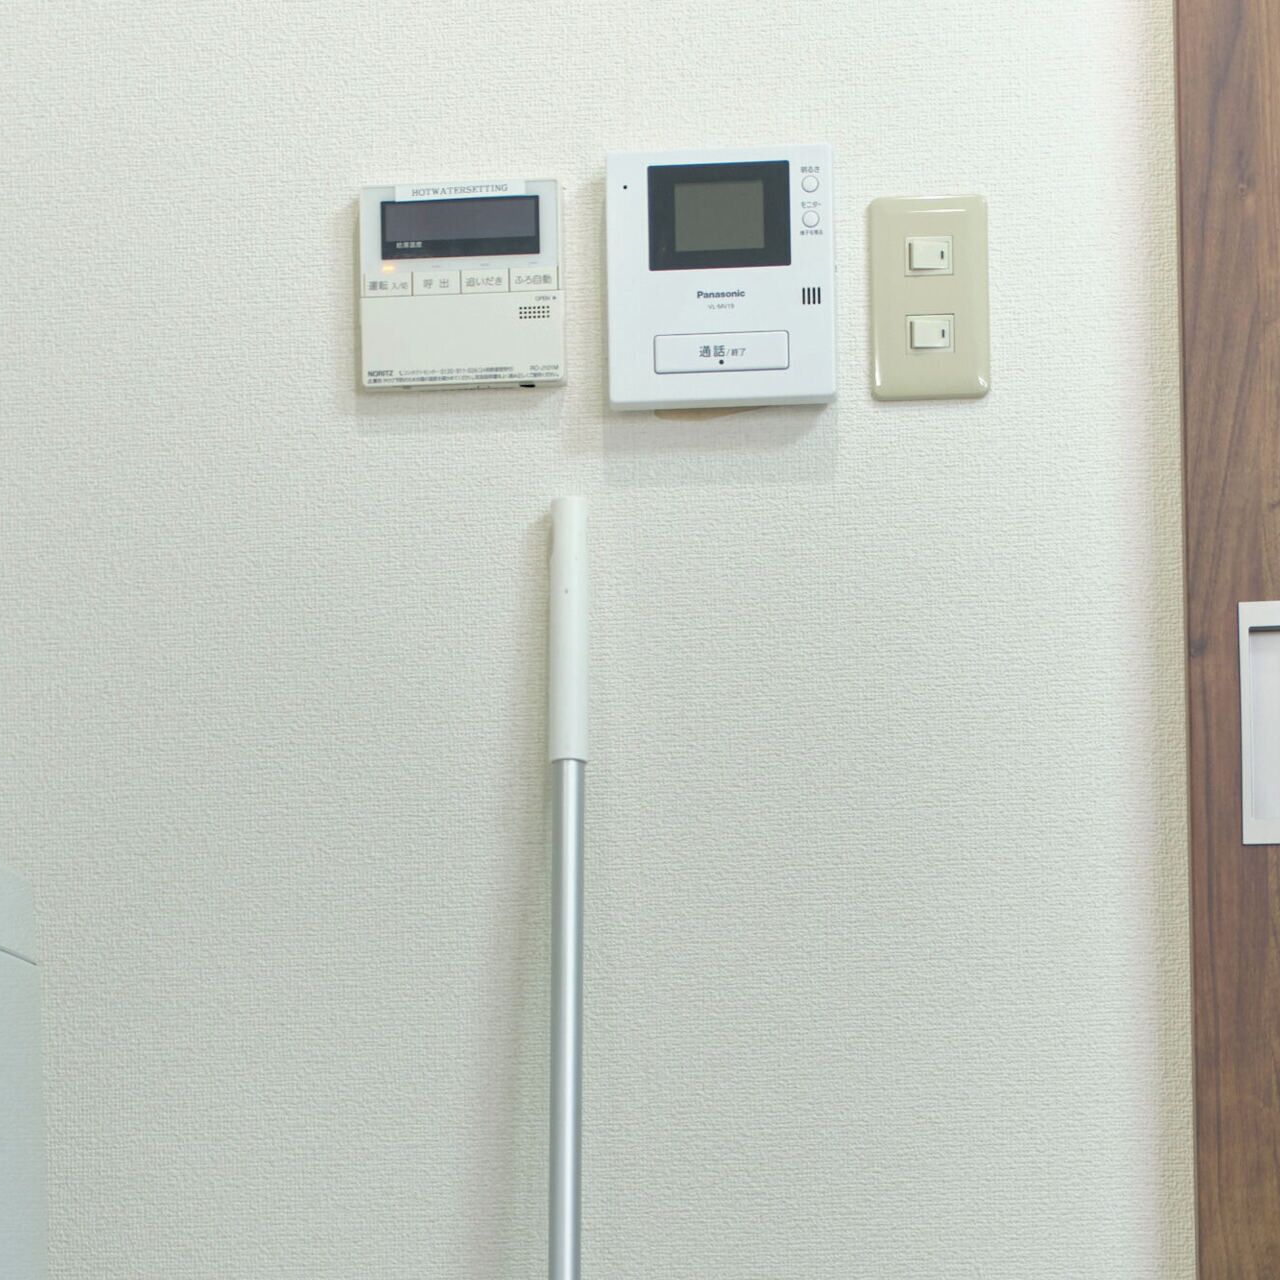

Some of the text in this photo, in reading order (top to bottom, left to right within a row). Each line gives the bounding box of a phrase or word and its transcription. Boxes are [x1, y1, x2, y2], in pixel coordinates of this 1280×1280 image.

[411, 184, 508, 197] HOTWATERSETTING
[697, 289, 745, 299] Panasonic
[367, 369, 394, 377] NORITZ
